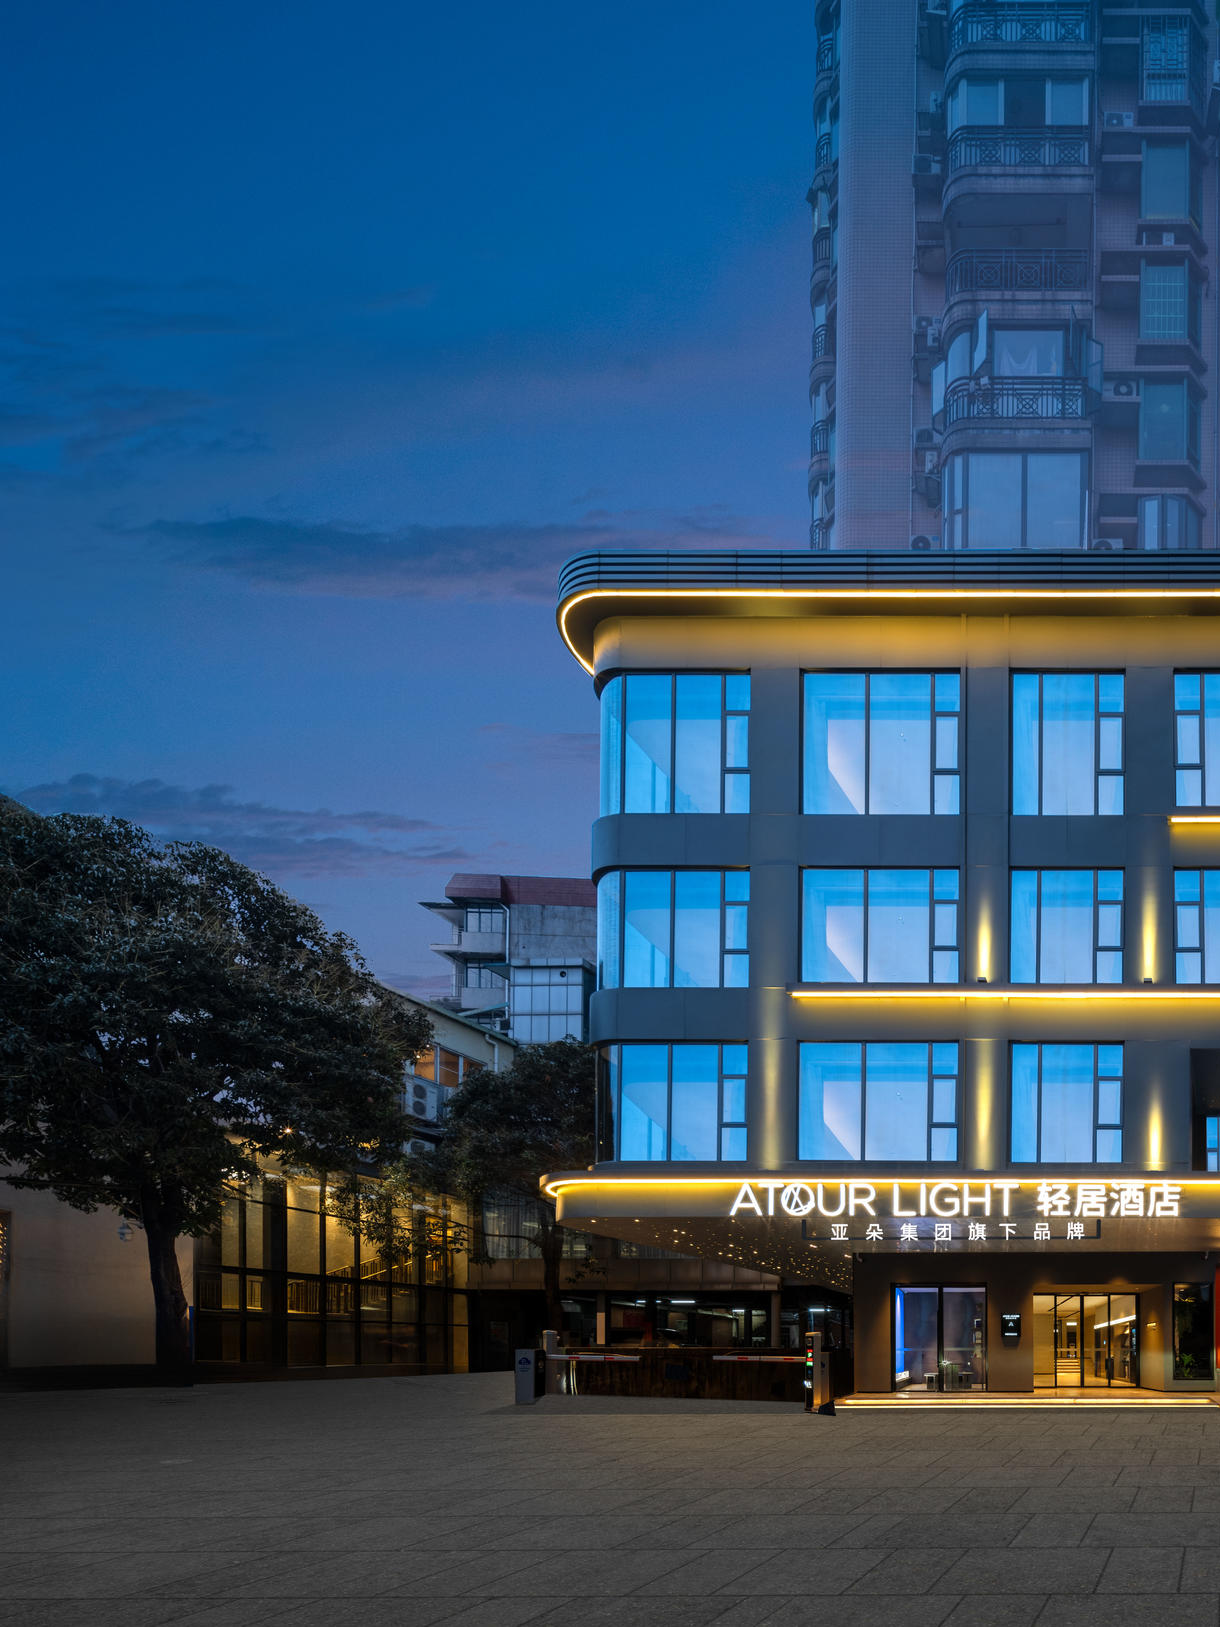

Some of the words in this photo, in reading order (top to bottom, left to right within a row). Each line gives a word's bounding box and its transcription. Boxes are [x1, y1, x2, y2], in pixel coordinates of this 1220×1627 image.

[729, 1183, 876, 1216] ATOUR
[893, 1183, 1019, 1216] LIGHT
[1036, 1181, 1182, 1217] 轻居酒店
[830, 1222, 1086, 1241] 亚朵集团旗下品牌
